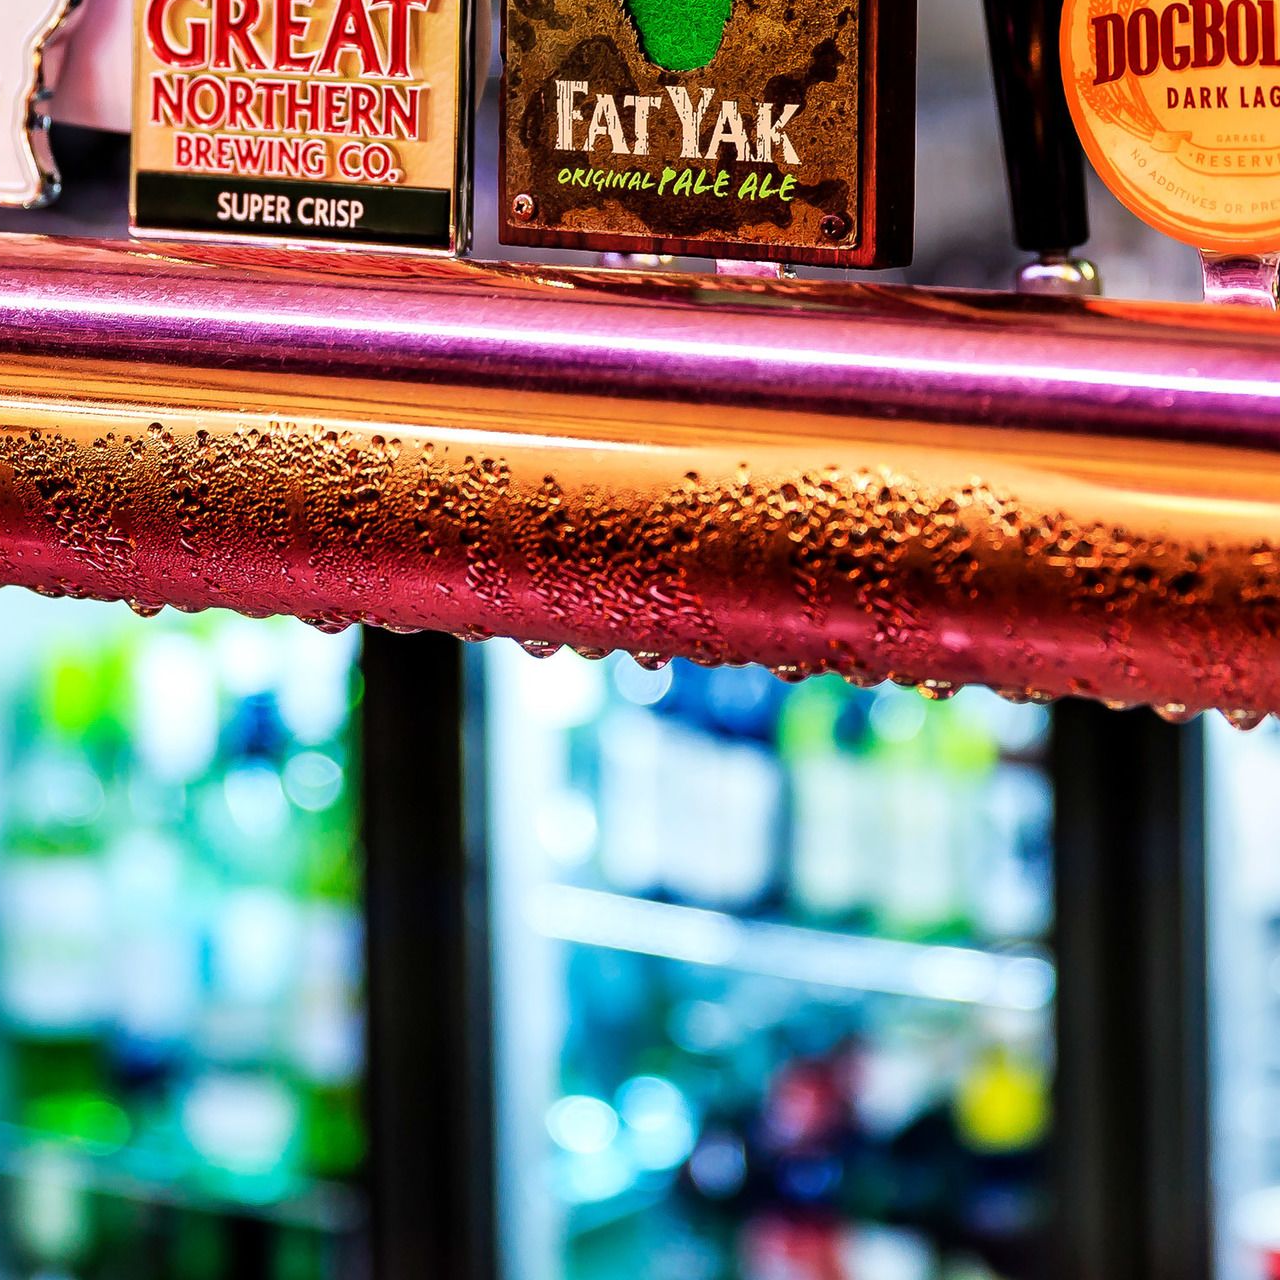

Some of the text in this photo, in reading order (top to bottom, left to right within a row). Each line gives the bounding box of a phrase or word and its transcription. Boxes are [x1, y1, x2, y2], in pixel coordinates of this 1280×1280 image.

[149, 72, 422, 142] NORTHERN
[1166, 86, 1229, 109] DARK
[1216, 133, 1266, 143] GARAGE
[174, 132, 400, 183] BREWING CO.
[557, 167, 798, 202] ORIGINAL PALE ALE
[1130, 148, 1148, 168] NO
[1148, 170, 1217, 211] ADDITIVES
[1224, 203, 1244, 214] OR
[217, 191, 364, 229] SUPER CRISP
